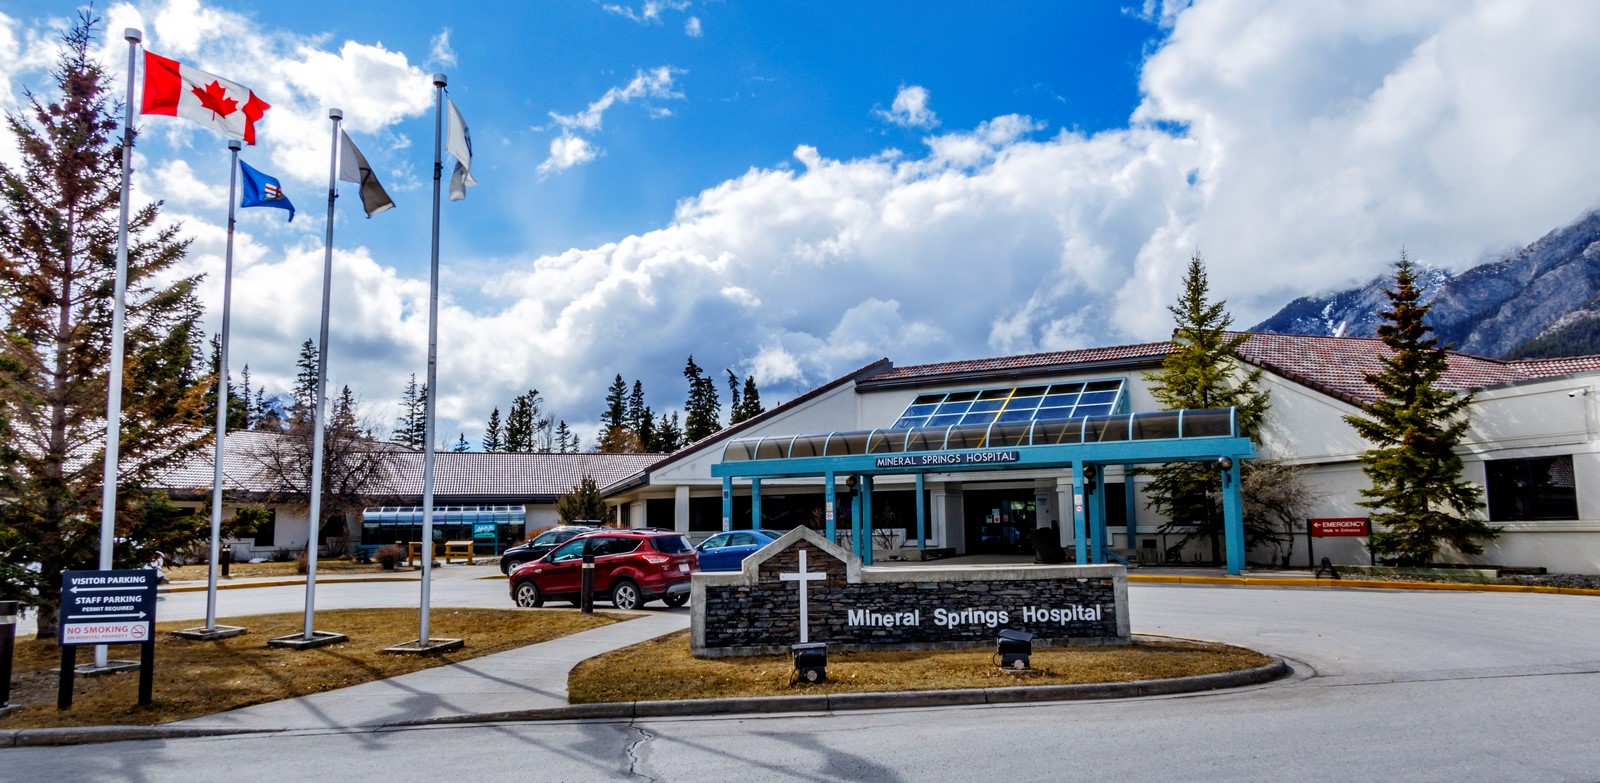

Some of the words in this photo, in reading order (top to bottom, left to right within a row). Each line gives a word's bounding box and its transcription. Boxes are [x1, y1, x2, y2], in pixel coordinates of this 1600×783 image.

[877, 458, 916, 467] MINERAL
[922, 454, 961, 464] SPRINGS
[966, 452, 1016, 462] HOSPITAL
[72, 577, 106, 585] VISITOR
[107, 576, 146, 584] PARKING
[75, 596, 102, 604] STAFF
[848, 609, 920, 626] Mineral
[934, 608, 1009, 630] Springs
[1022, 604, 1102, 626] Hospital
[84, 626, 128, 634] SMOKING
